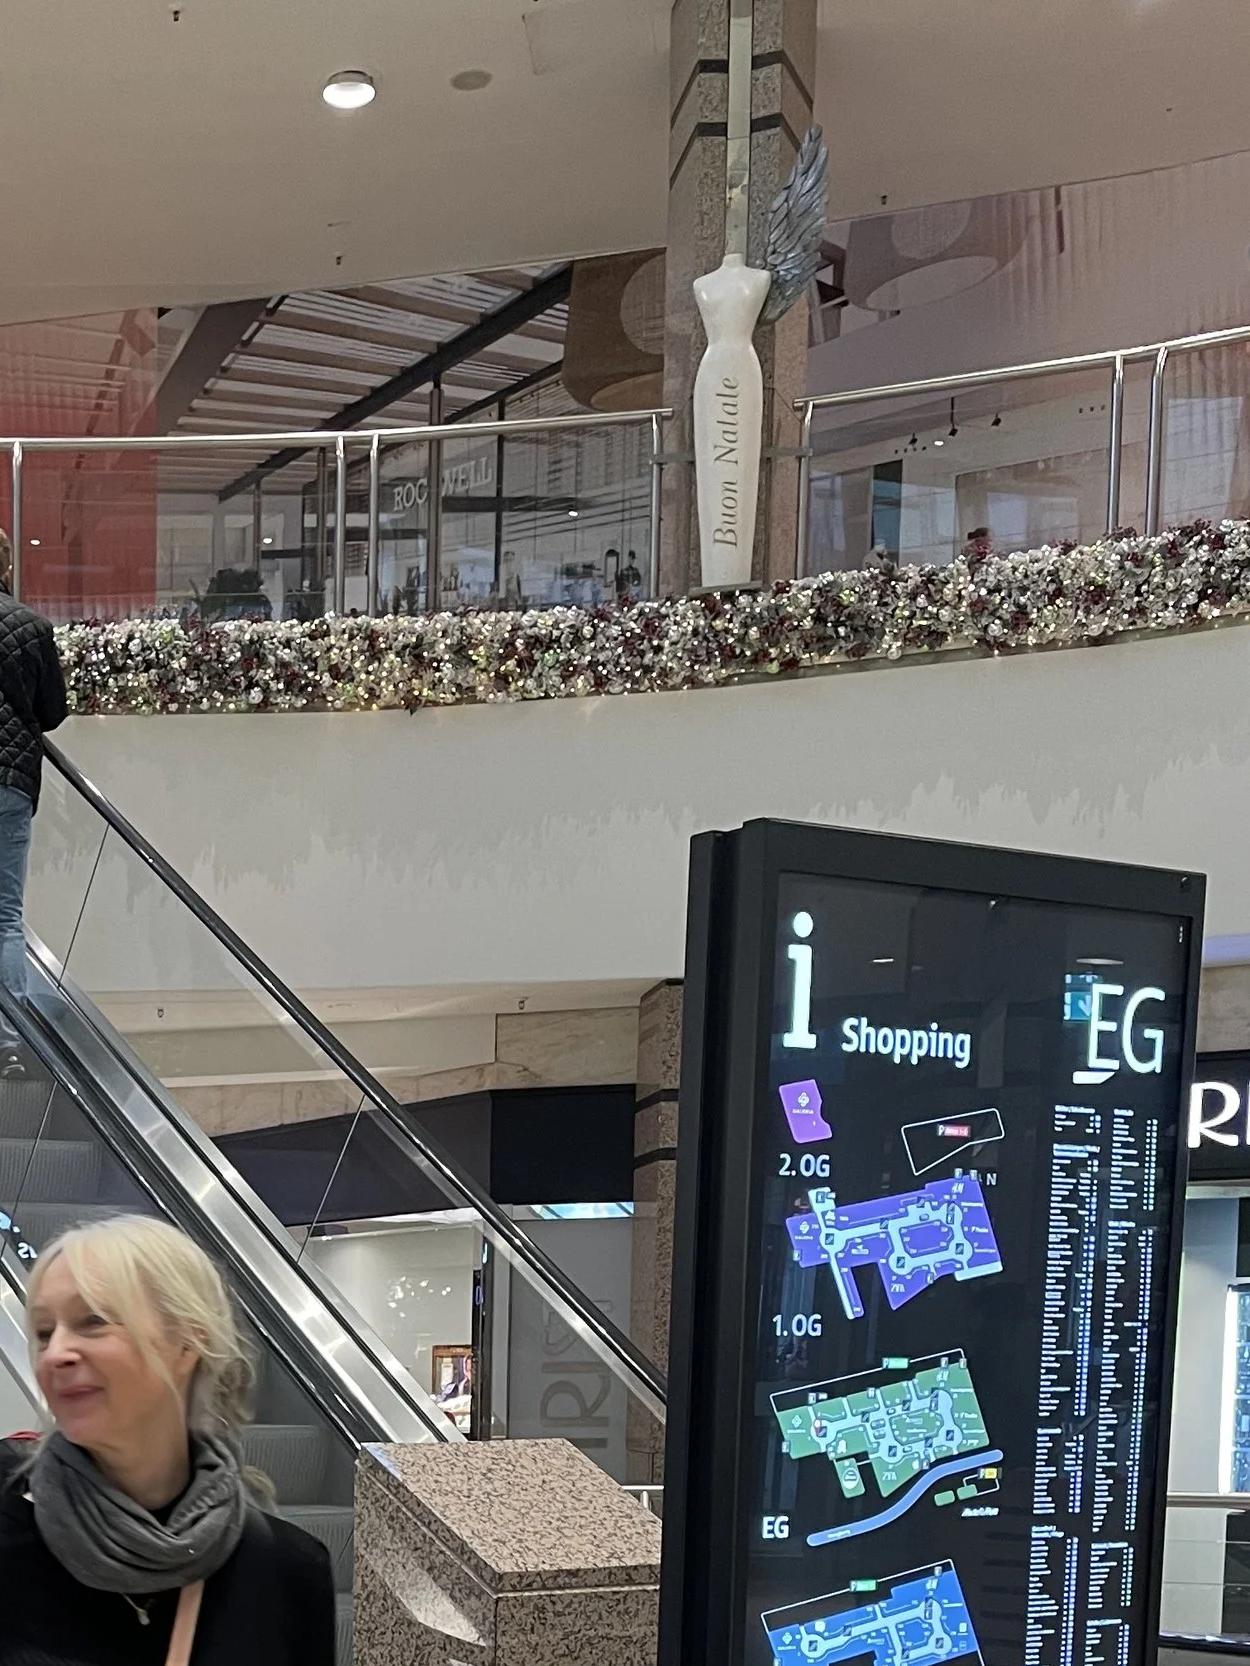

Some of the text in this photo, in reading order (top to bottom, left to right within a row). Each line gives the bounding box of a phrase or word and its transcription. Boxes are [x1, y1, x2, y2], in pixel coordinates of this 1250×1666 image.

[393, 456, 493, 512] ROCWELL
[712, 480, 739, 548] Buon
[841, 1017, 972, 1069] Shopping
[1088, 983, 1166, 1074] EG
[800, 1153, 831, 1177] OG
[986, 1173, 997, 1186] N
[791, 1314, 822, 1337] OG
[762, 1515, 790, 1539] EG
